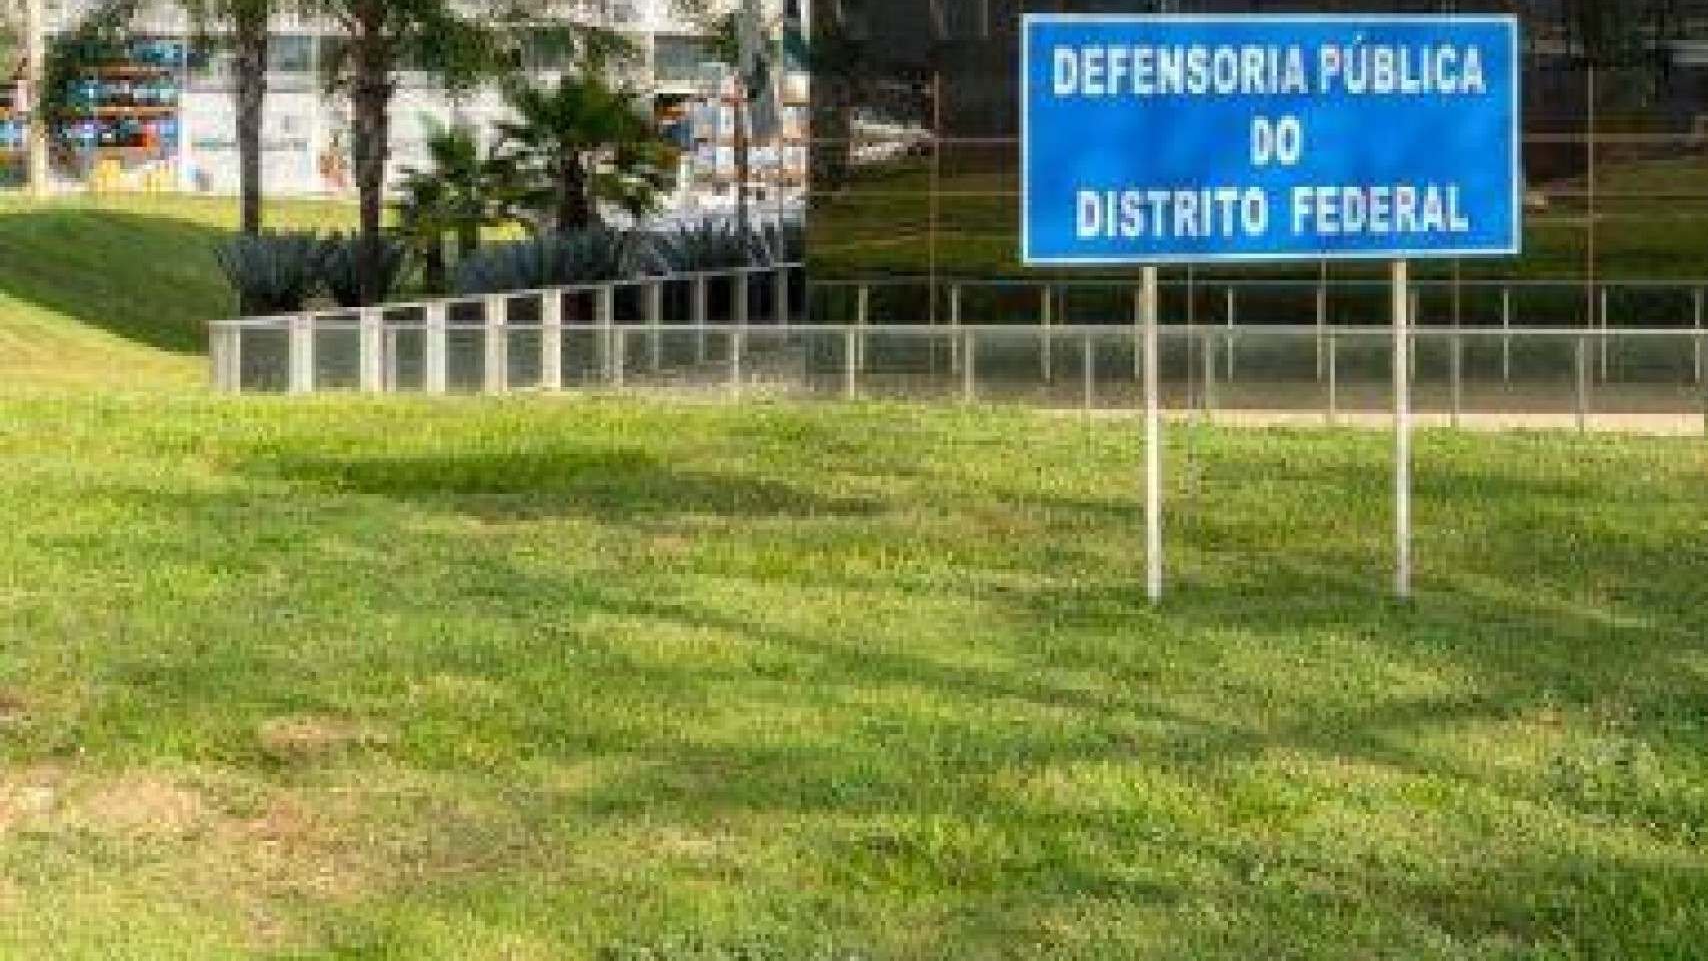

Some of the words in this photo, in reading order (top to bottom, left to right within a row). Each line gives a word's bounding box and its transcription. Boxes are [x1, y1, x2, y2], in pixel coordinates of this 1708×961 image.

[1053, 43, 1309, 95] DEFENSORIA
[1319, 33, 1487, 95] PÚBLICA
[1250, 114, 1303, 165] DO
[1076, 188, 1269, 238] DISTRITO
[1290, 184, 1469, 234] FEDERAL
